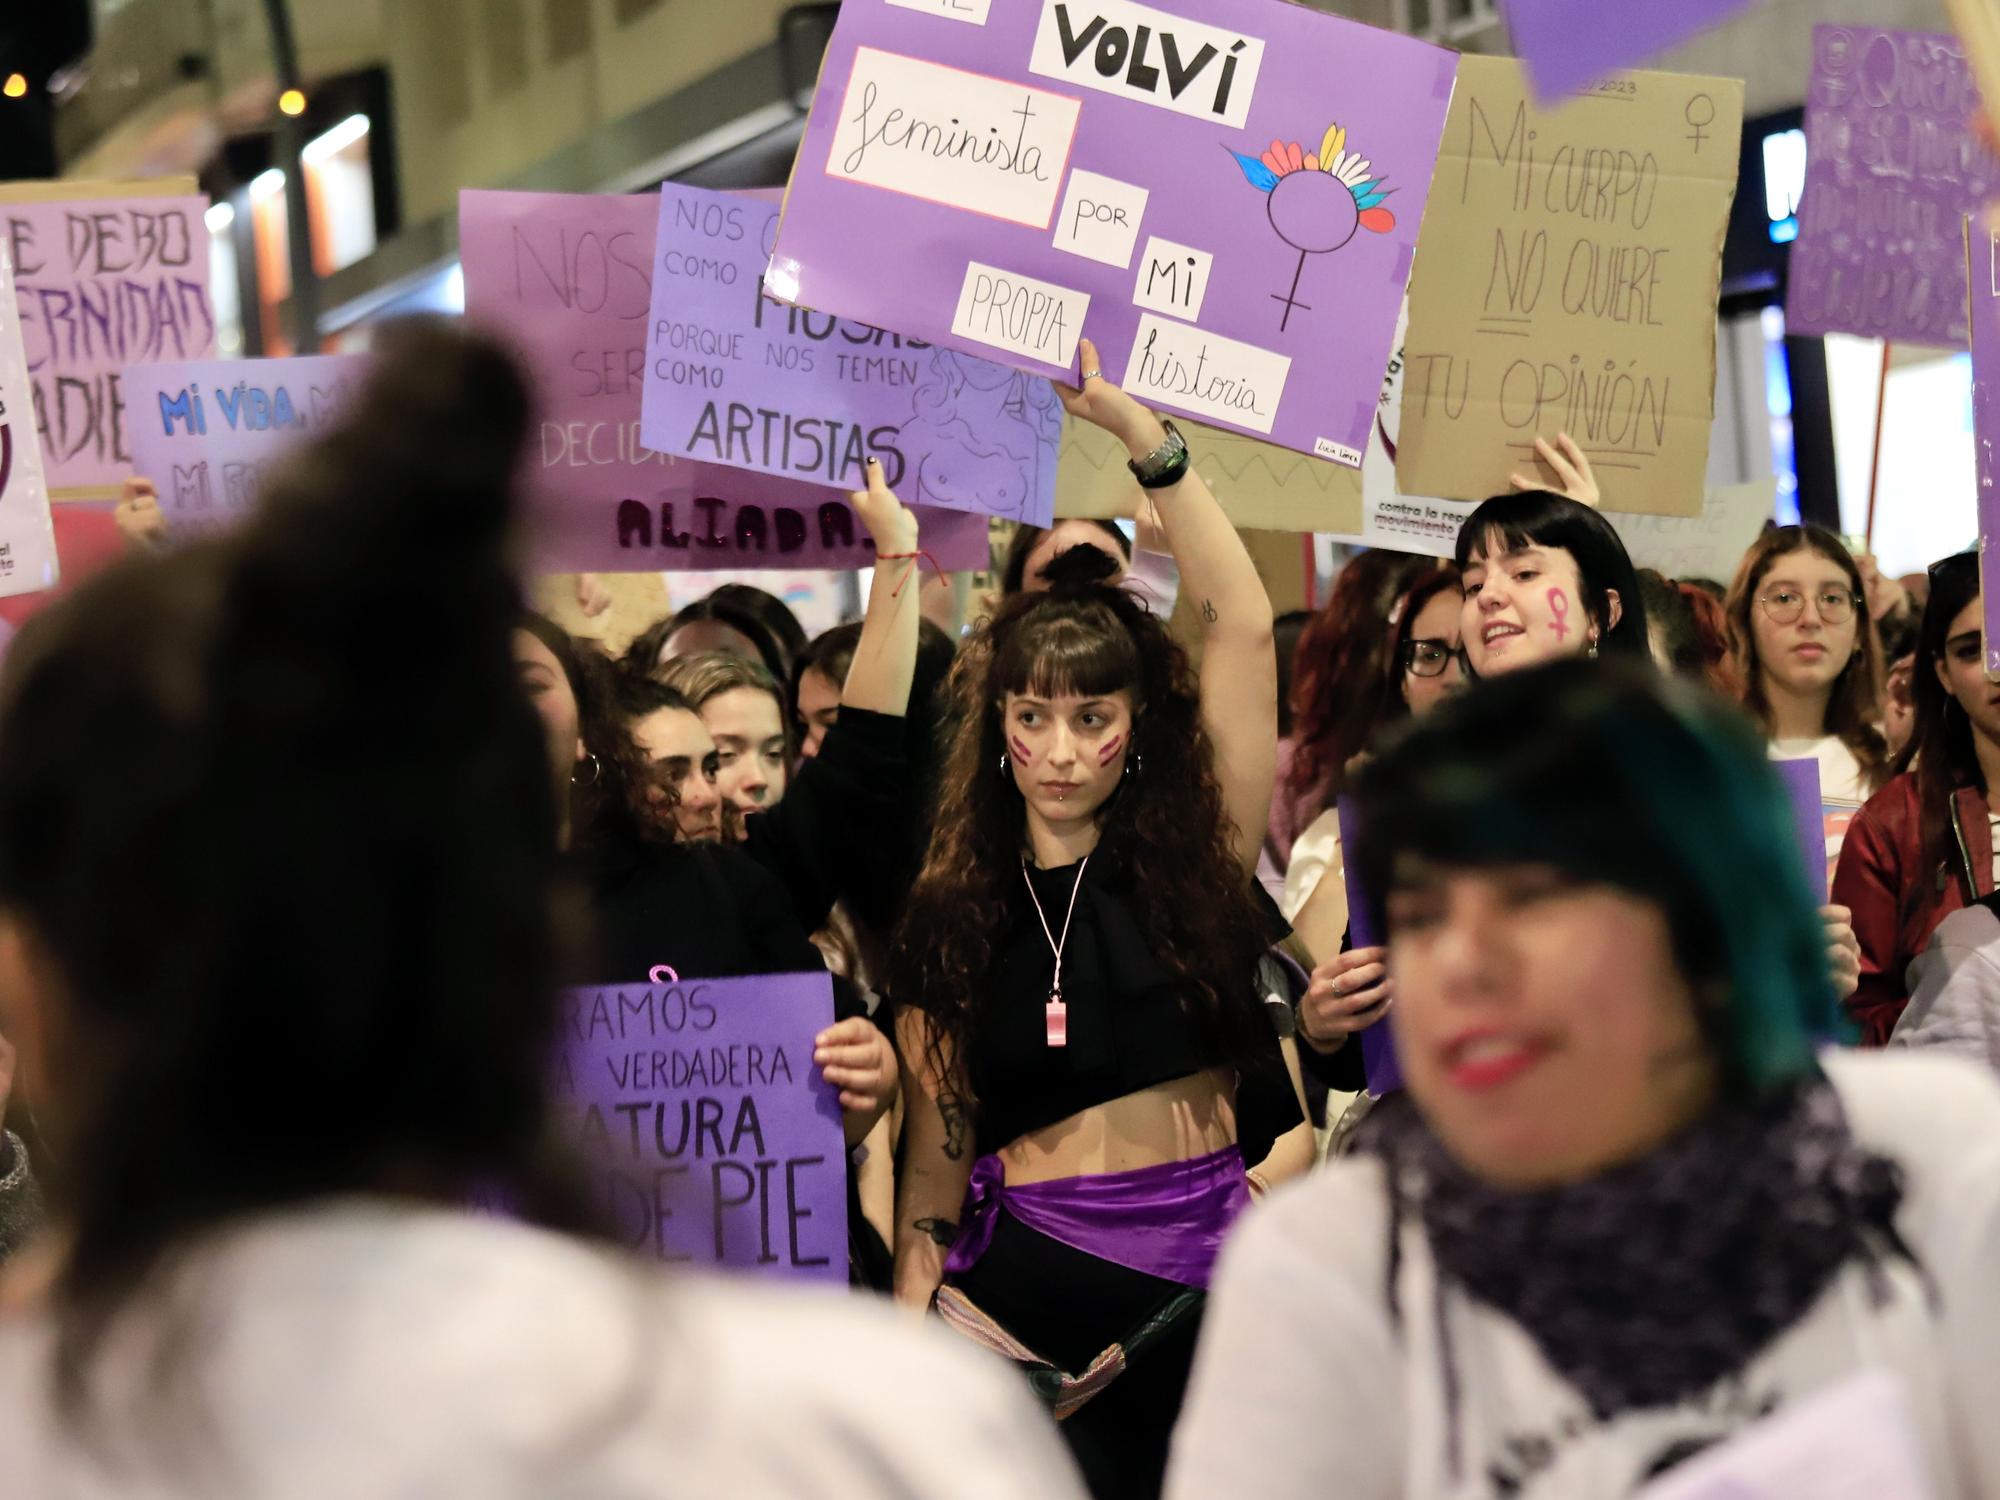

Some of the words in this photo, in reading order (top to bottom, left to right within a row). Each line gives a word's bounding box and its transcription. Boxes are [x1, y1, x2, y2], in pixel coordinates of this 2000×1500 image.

[1054, 2, 1247, 115] VOLVÍ
[844, 82, 1050, 182] feminista
[675, 199, 745, 241] NOS
[1544, 145, 1659, 230] CUERPO
[65, 210, 191, 275] DEBO
[512, 224, 652, 320] NOS
[664, 250, 738, 285] COMO
[1484, 228, 1548, 314] NO
[1561, 237, 1670, 326] QUIERE
[968, 272, 1067, 362] PROPIA
[655, 319, 745, 361] PORQUE
[765, 342, 815, 373] NOS
[837, 353, 919, 386] TEMEN
[655, 358, 724, 390] COMO
[1140, 328, 1266, 417] historia
[1416, 353, 1470, 421] TU
[541, 421, 675, 468] DECID
[685, 400, 906, 491] ARTISTAS
[616, 498, 877, 554] ALIADA
[1374, 513, 1455, 534] movimiento
[1378, 502, 1422, 517] contra
[606, 1044, 794, 1090] VERDADERA
[711, 1155, 830, 1267] PIE
